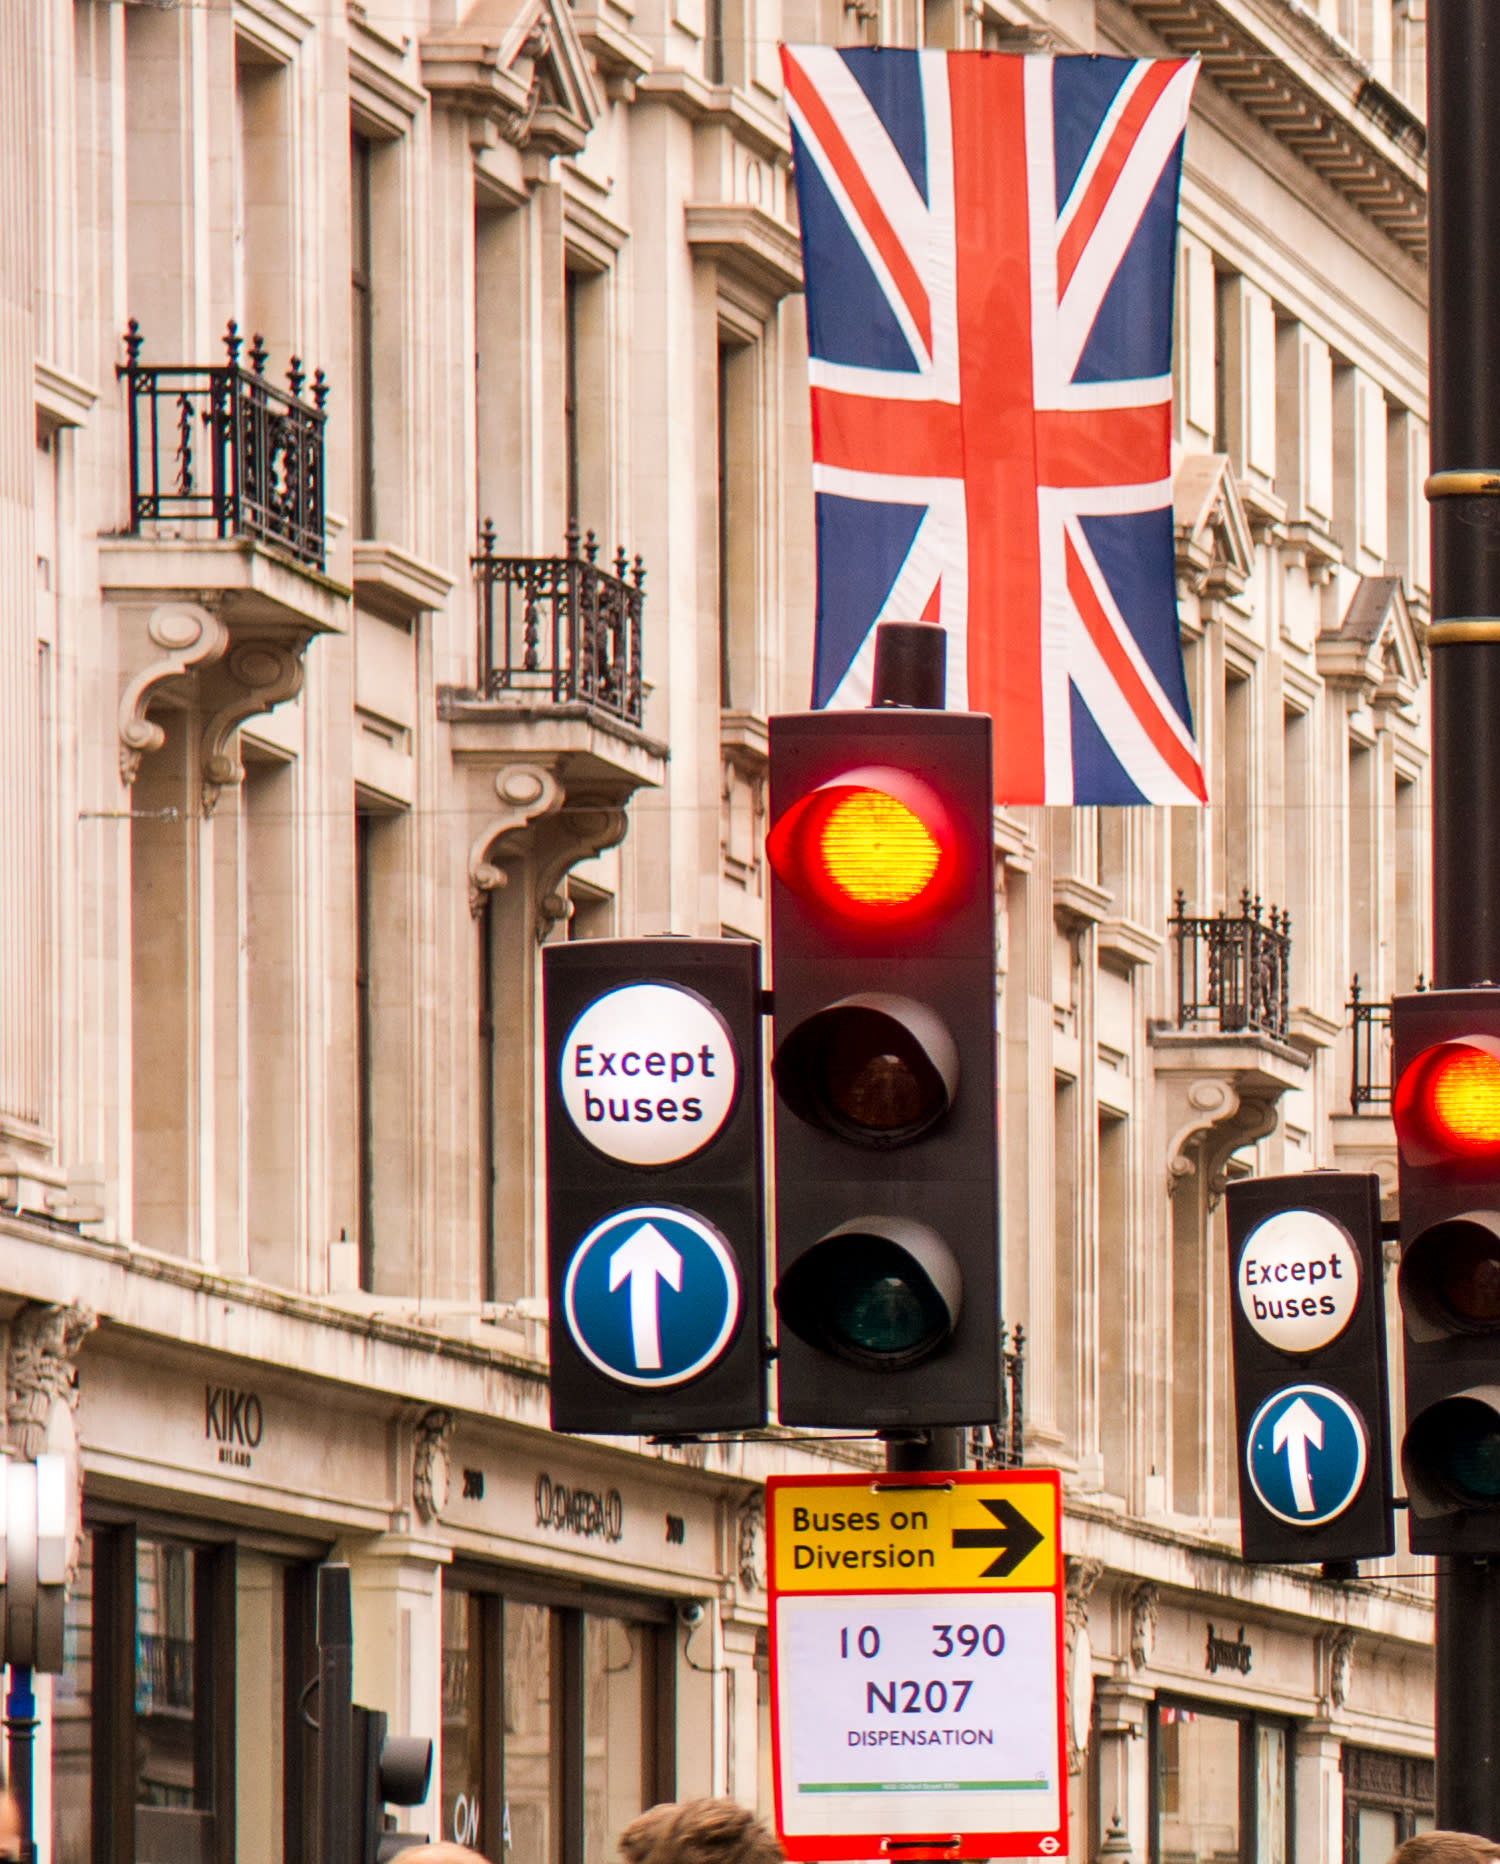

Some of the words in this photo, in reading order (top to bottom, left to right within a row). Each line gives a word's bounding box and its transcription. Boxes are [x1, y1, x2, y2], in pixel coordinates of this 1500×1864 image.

[575, 1044, 716, 1083] Except
[584, 1088, 703, 1123] buses
[1246, 1253, 1343, 1286] Except
[1252, 1294, 1336, 1320] buses
[204, 1384, 263, 1450] KIKO
[218, 1447, 252, 1468] MILANO
[792, 1507, 880, 1532] Buses
[890, 1510, 929, 1531] on
[793, 1544, 935, 1570] Diversion
[840, 1625, 881, 1659] 10
[931, 1623, 1006, 1657] 390
[866, 1680, 974, 1714] N207
[847, 1729, 994, 1747] DISPENSATION
